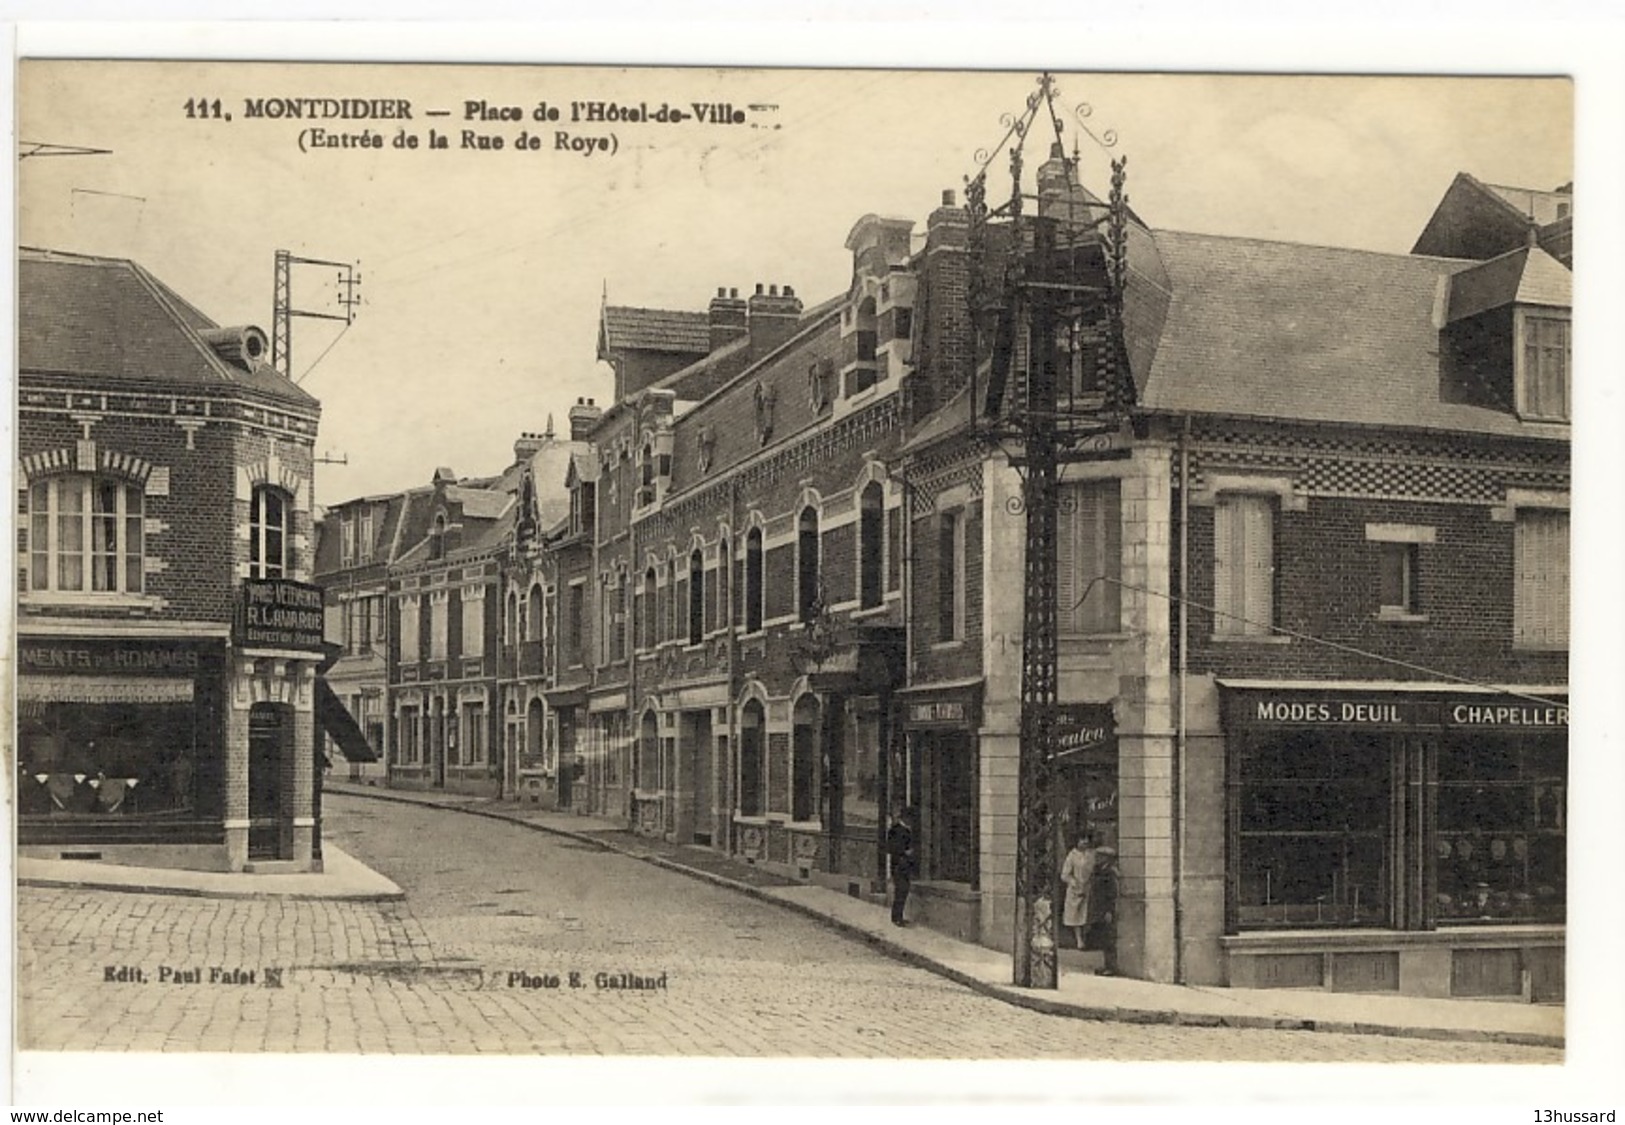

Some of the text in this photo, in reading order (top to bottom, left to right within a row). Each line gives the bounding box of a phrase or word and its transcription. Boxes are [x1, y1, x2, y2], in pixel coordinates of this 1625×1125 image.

[113, 649, 199, 669] HOMMES
[1341, 703, 1402, 723] DEUIL
[1453, 704, 1568, 725] CHAPELLER
